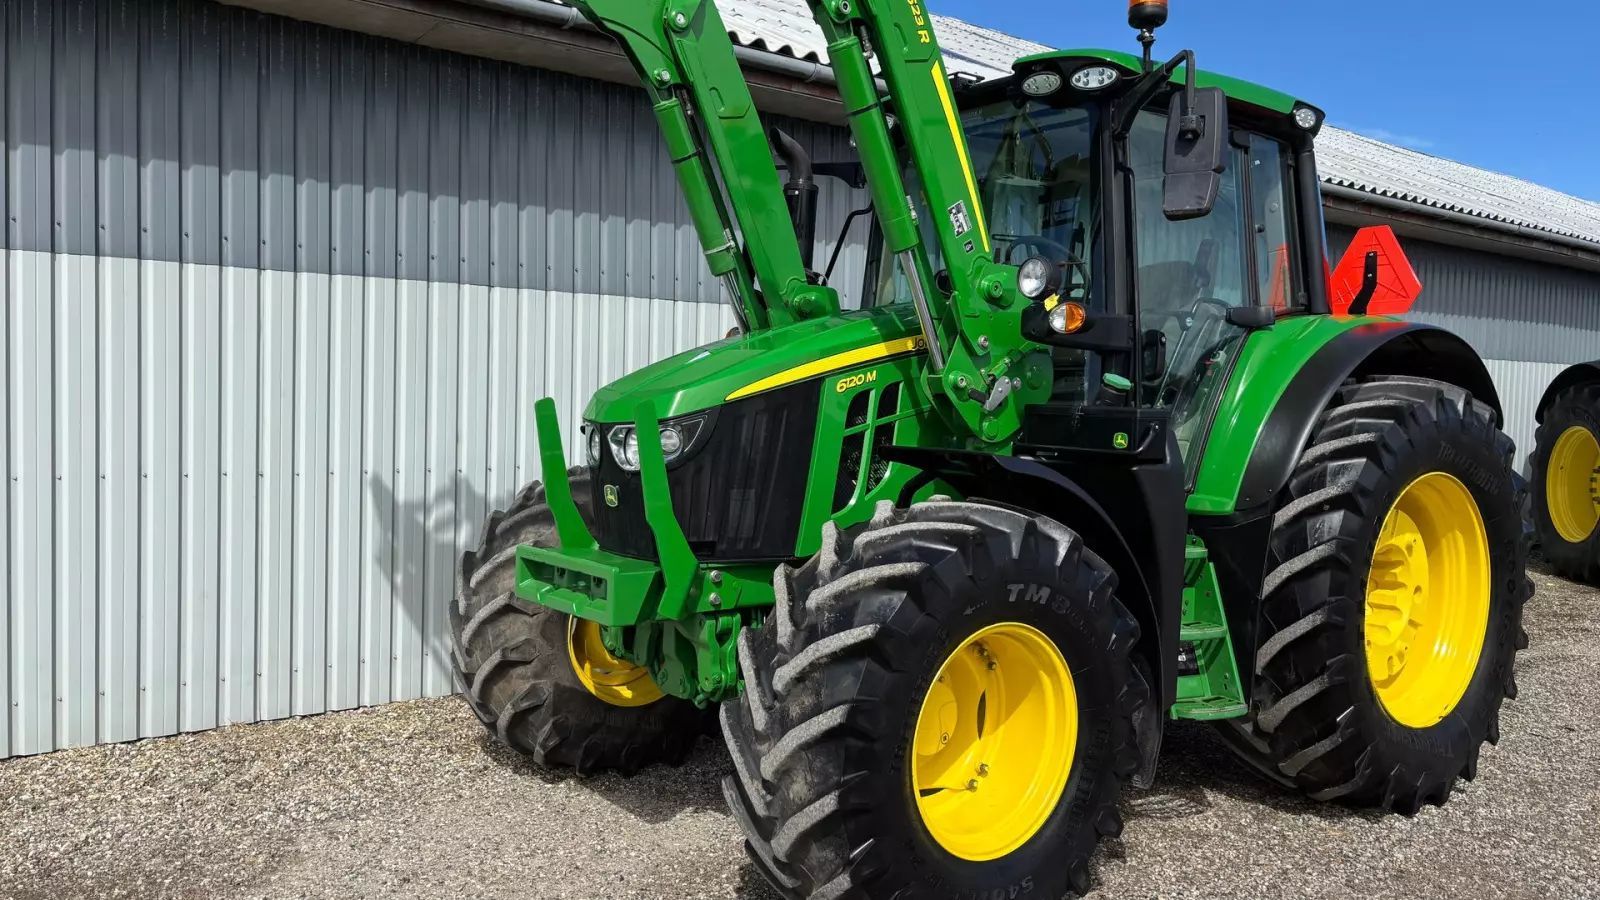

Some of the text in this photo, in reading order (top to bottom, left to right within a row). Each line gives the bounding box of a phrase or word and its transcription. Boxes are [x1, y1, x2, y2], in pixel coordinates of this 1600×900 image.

[917, 29, 930, 43] R
[836, 370, 877, 393] 6120 M
